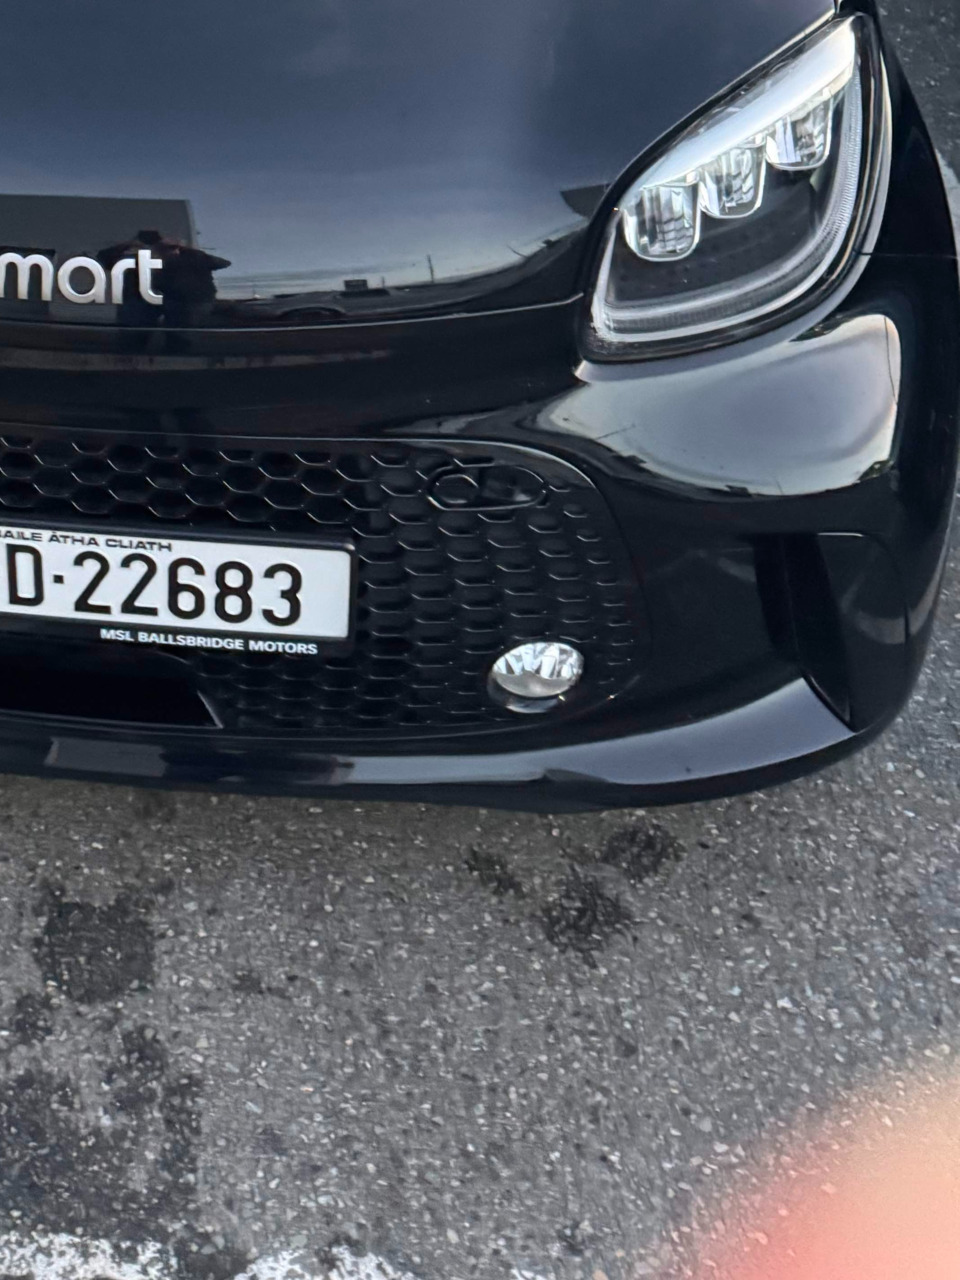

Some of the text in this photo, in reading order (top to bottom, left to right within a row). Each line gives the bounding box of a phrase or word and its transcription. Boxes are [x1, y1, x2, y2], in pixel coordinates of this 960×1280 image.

[105, 538, 172, 552] CLIATH
[100, 628, 319, 655] MSL BALLSBRIDGE MOTORS
